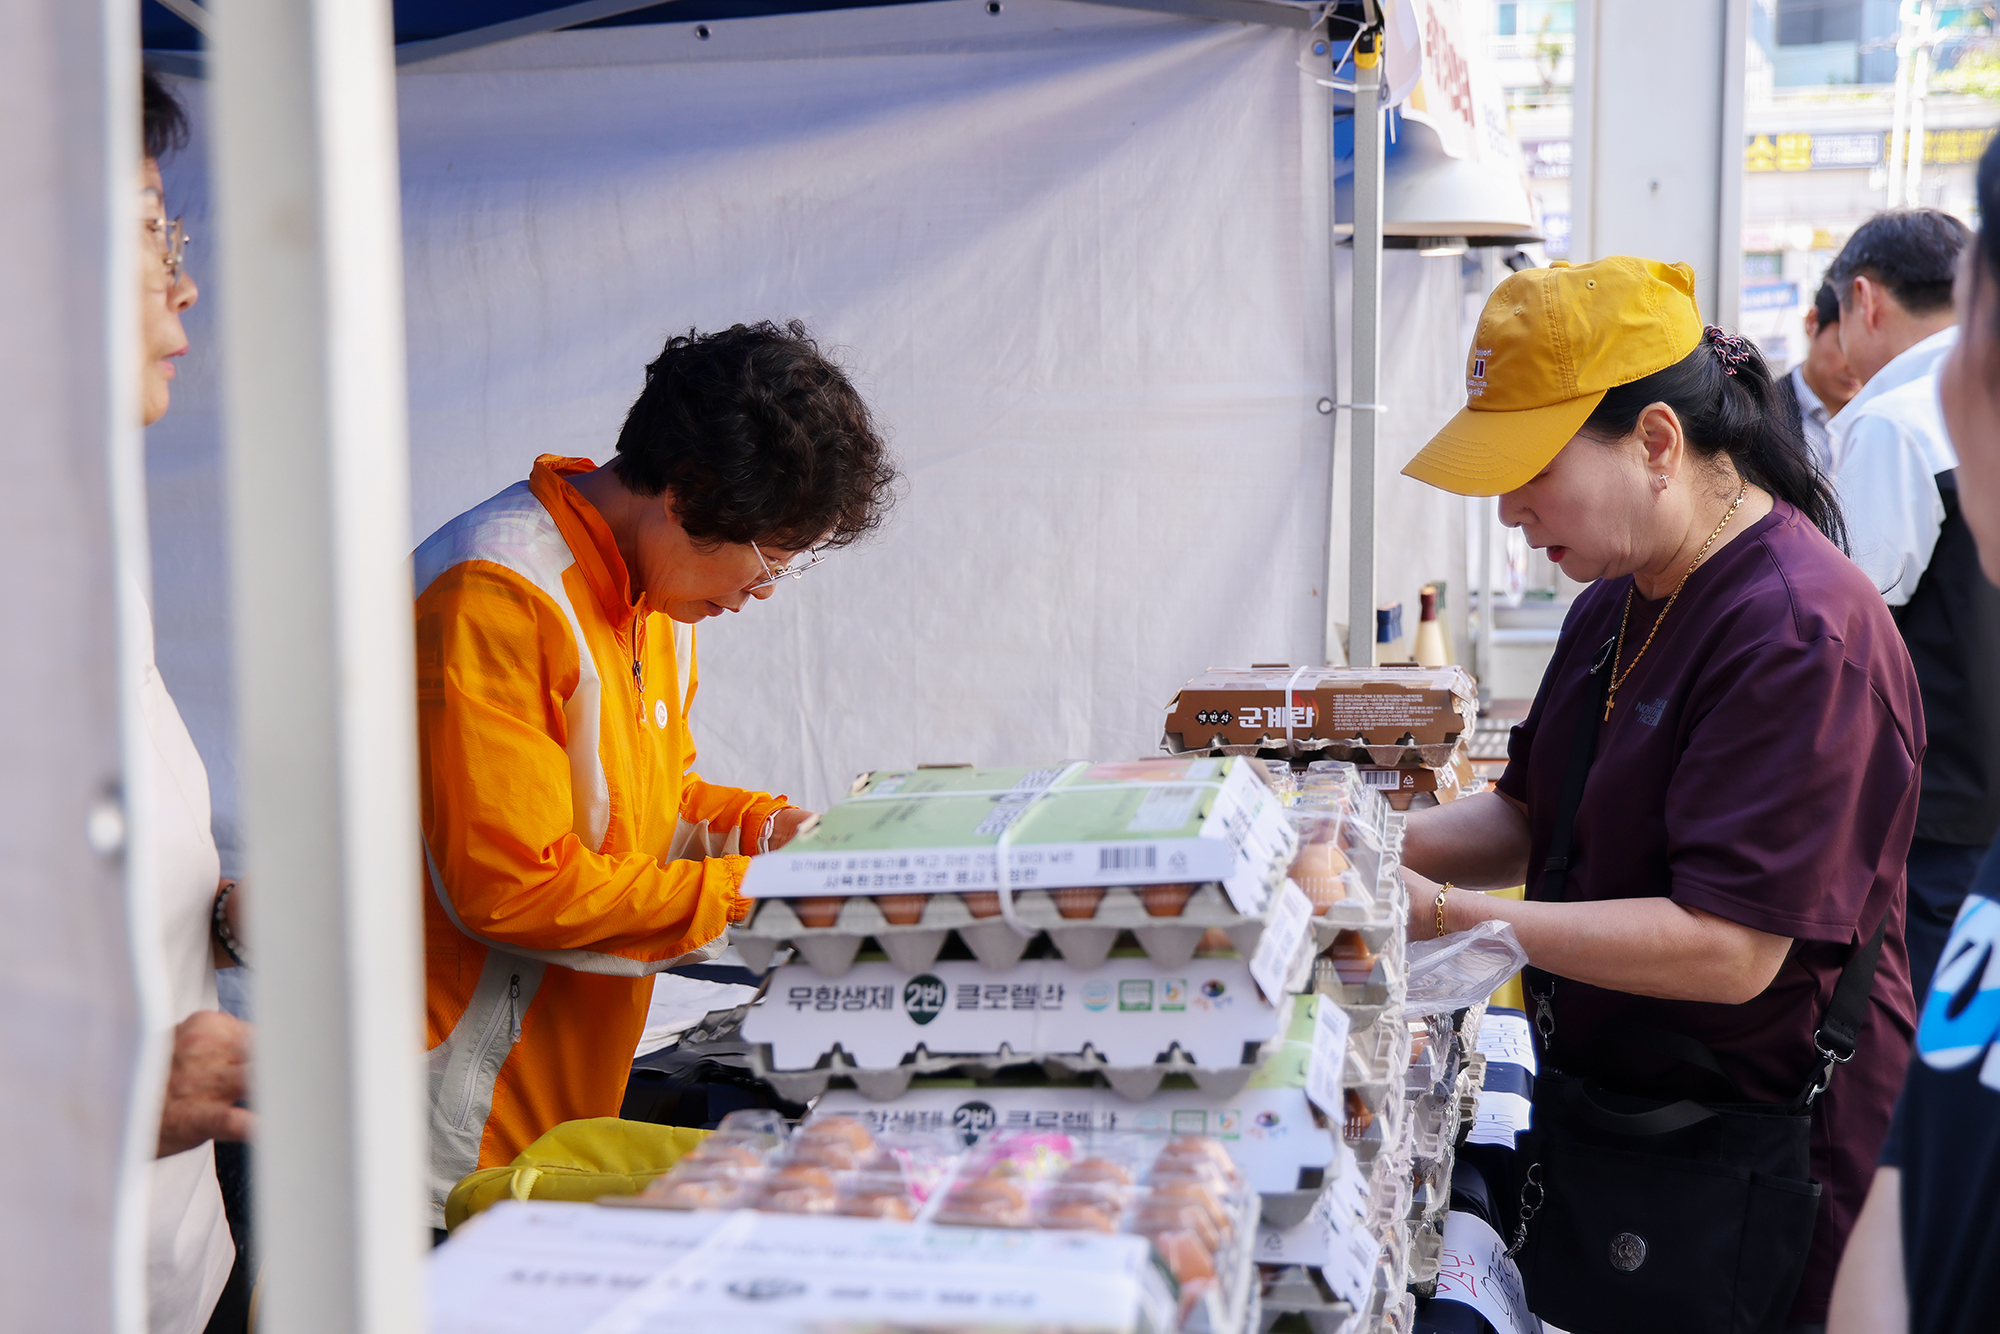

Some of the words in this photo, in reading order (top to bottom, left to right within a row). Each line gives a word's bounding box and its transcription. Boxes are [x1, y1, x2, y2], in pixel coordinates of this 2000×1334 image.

[1238, 706, 1315, 728] 군계란
[787, 985, 894, 1012] 무항생제
[907, 982, 944, 1009] 2번
